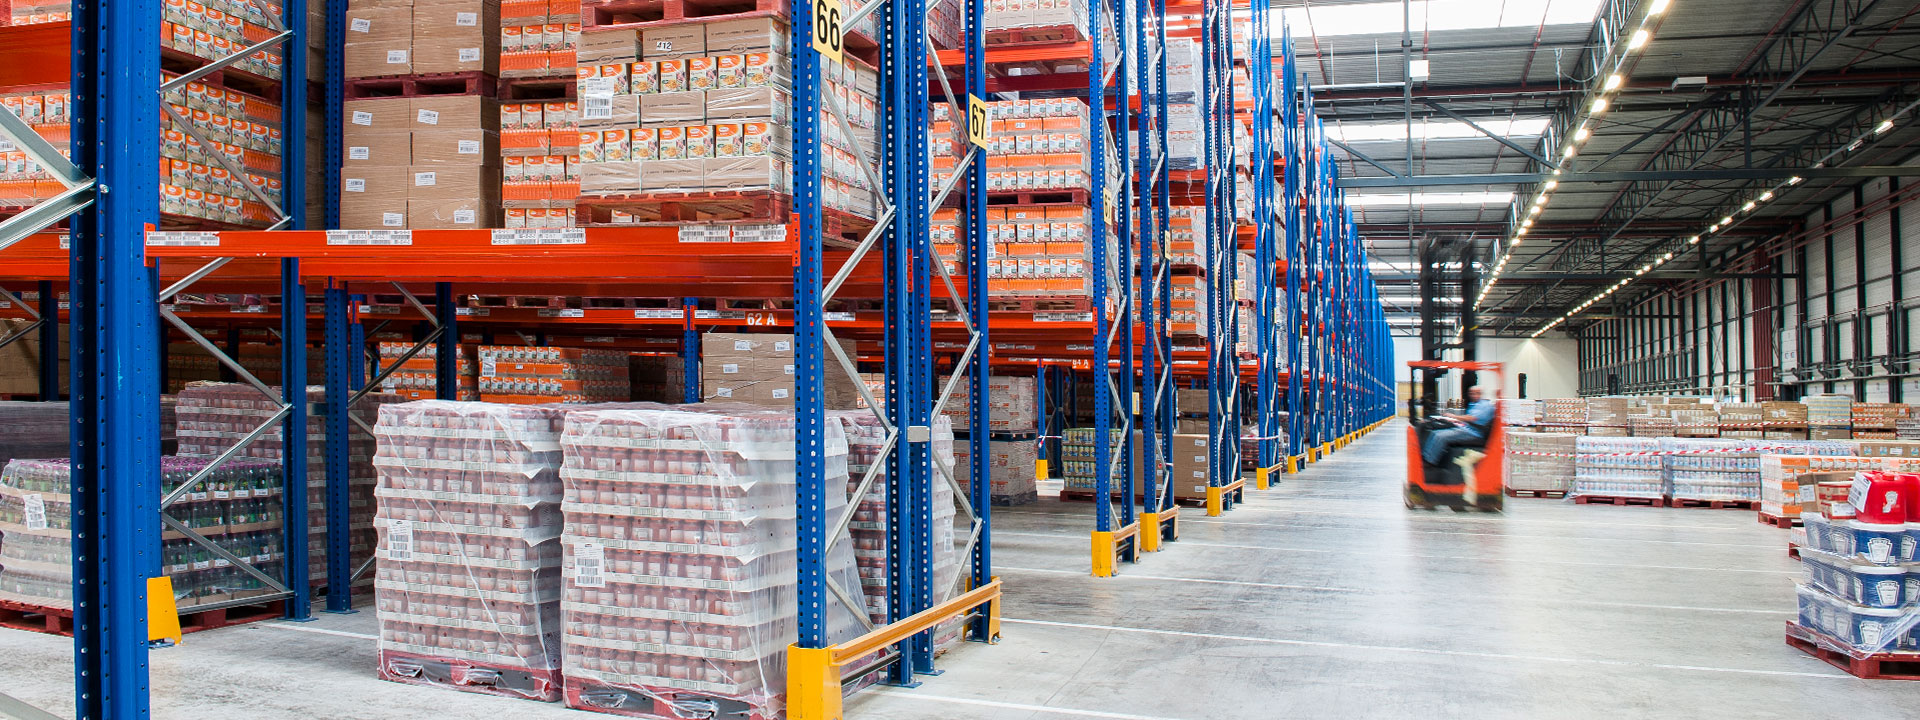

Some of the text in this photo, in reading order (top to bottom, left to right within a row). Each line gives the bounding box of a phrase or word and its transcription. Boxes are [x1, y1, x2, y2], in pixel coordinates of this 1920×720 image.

[817, 0, 840, 52] 66
[972, 103, 986, 140] 67
[747, 312, 776, 326] 62 A
